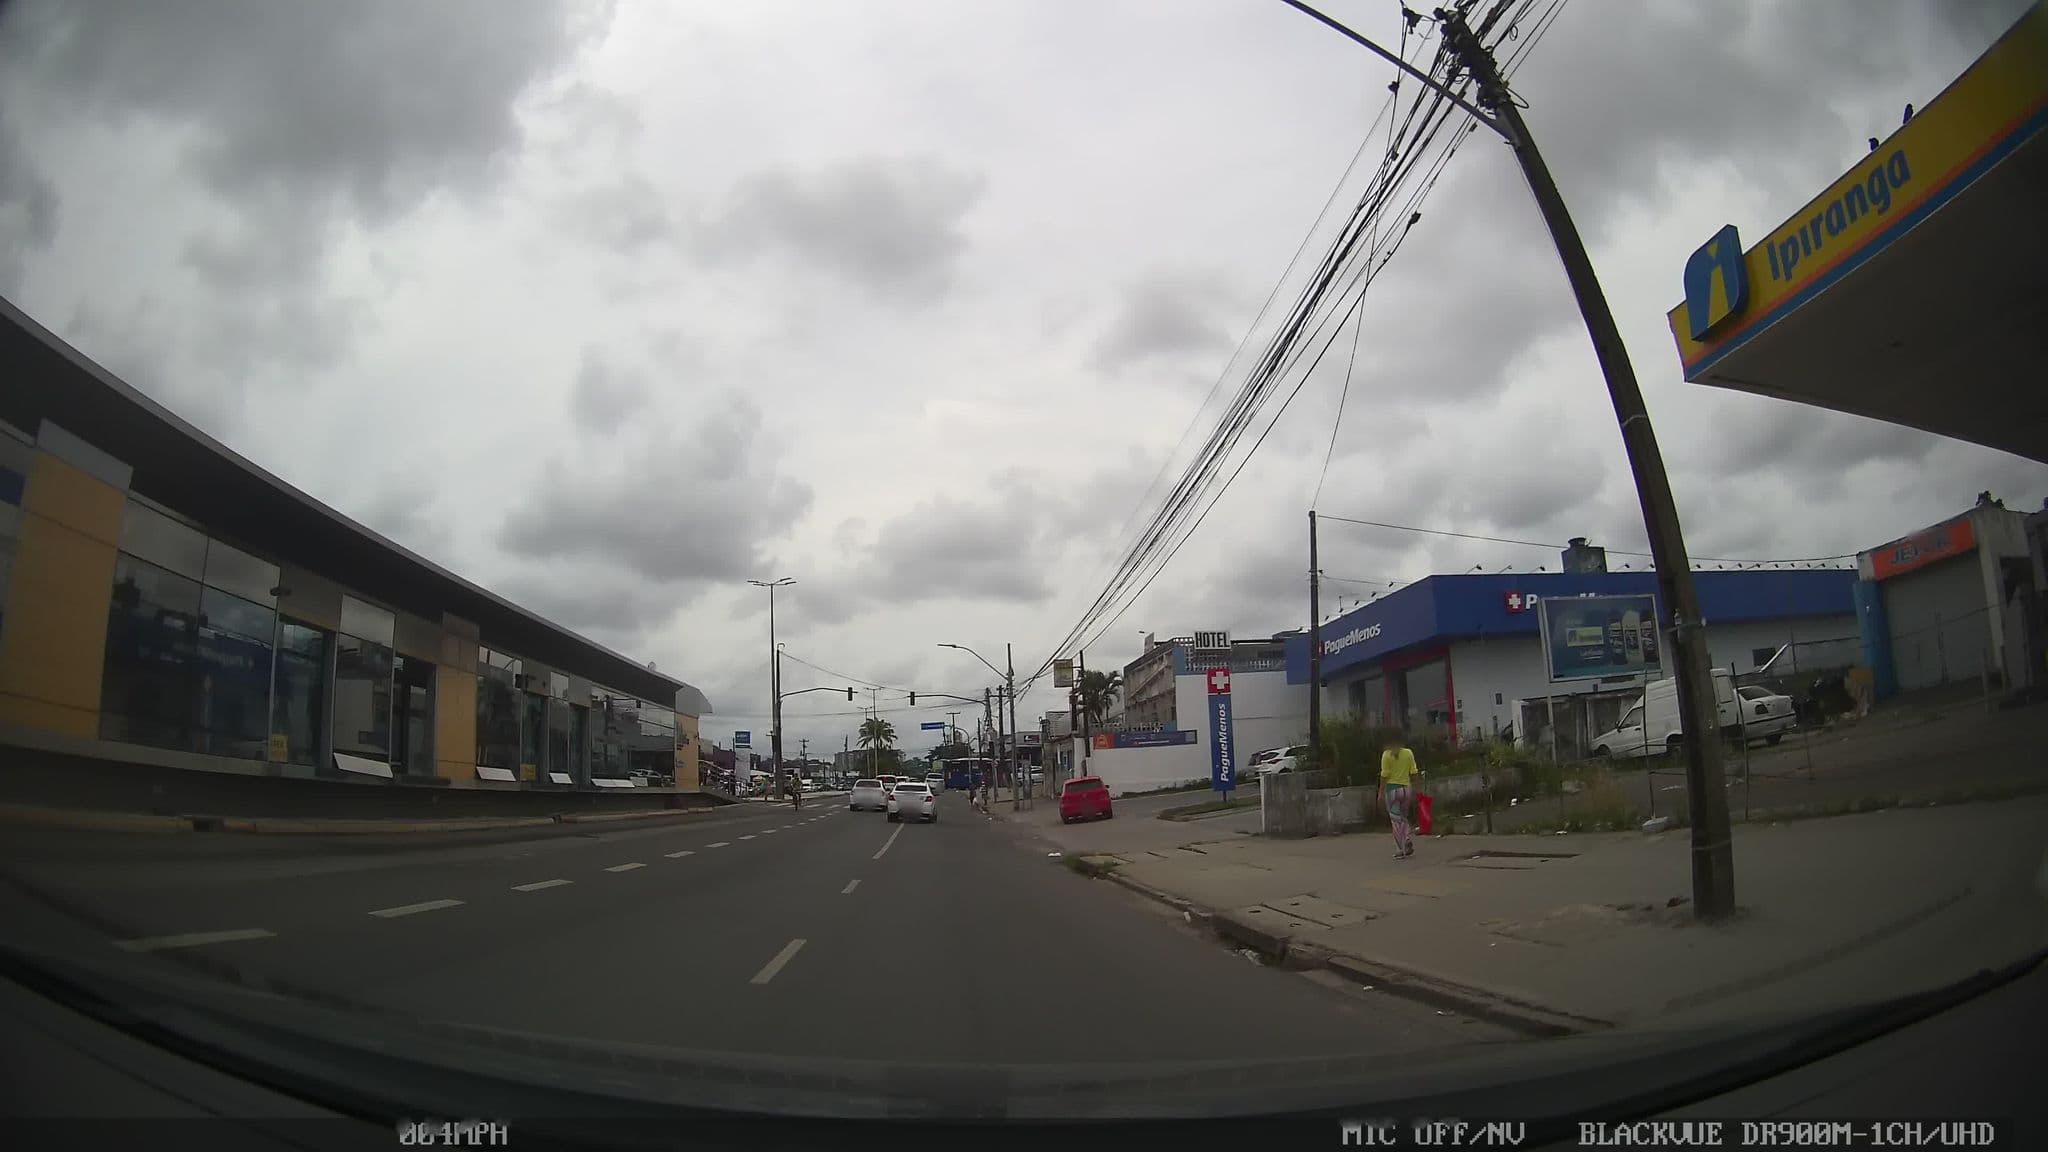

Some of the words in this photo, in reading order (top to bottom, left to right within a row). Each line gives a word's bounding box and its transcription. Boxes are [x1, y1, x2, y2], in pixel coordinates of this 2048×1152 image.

[1767, 149, 1911, 281] Ipiranga
[1195, 631, 1231, 648] HOTEL
[1325, 623, 1381, 655] PagueMenos
[1218, 703, 1231, 782] PagueMenos
